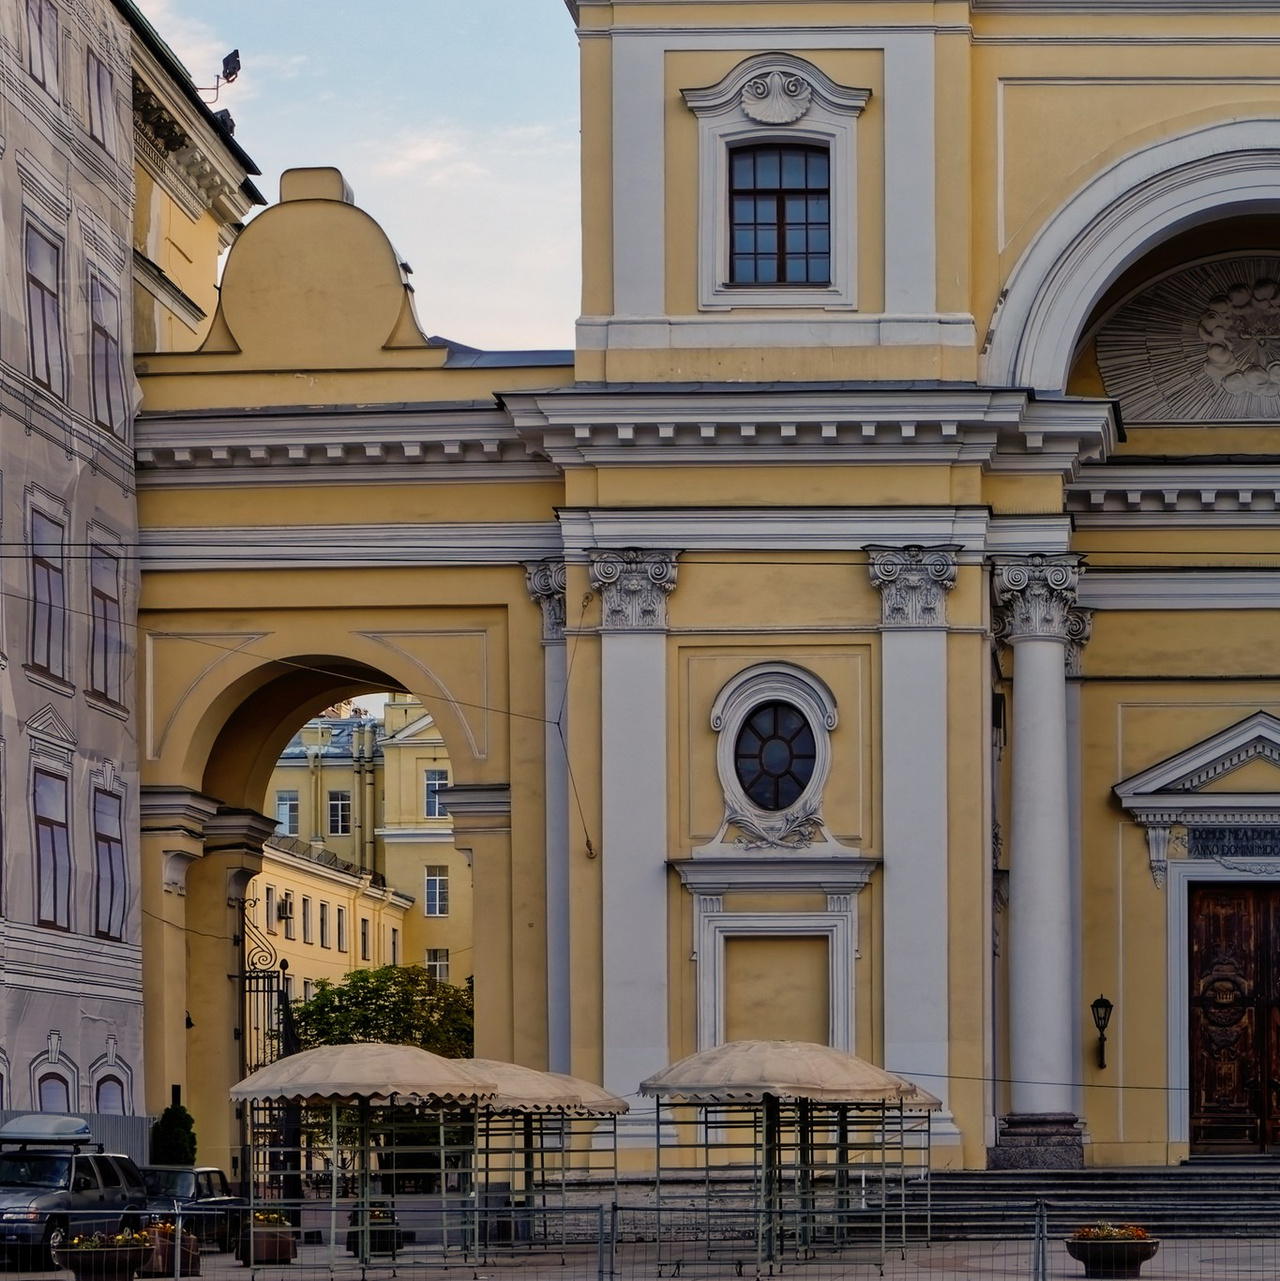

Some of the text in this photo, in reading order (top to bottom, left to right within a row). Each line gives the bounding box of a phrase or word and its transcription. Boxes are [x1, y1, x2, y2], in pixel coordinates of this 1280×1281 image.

[1193, 829, 1226, 840] DOMUS
[1228, 829, 1248, 840] MEA
[1193, 844, 1219, 856] ANNO
